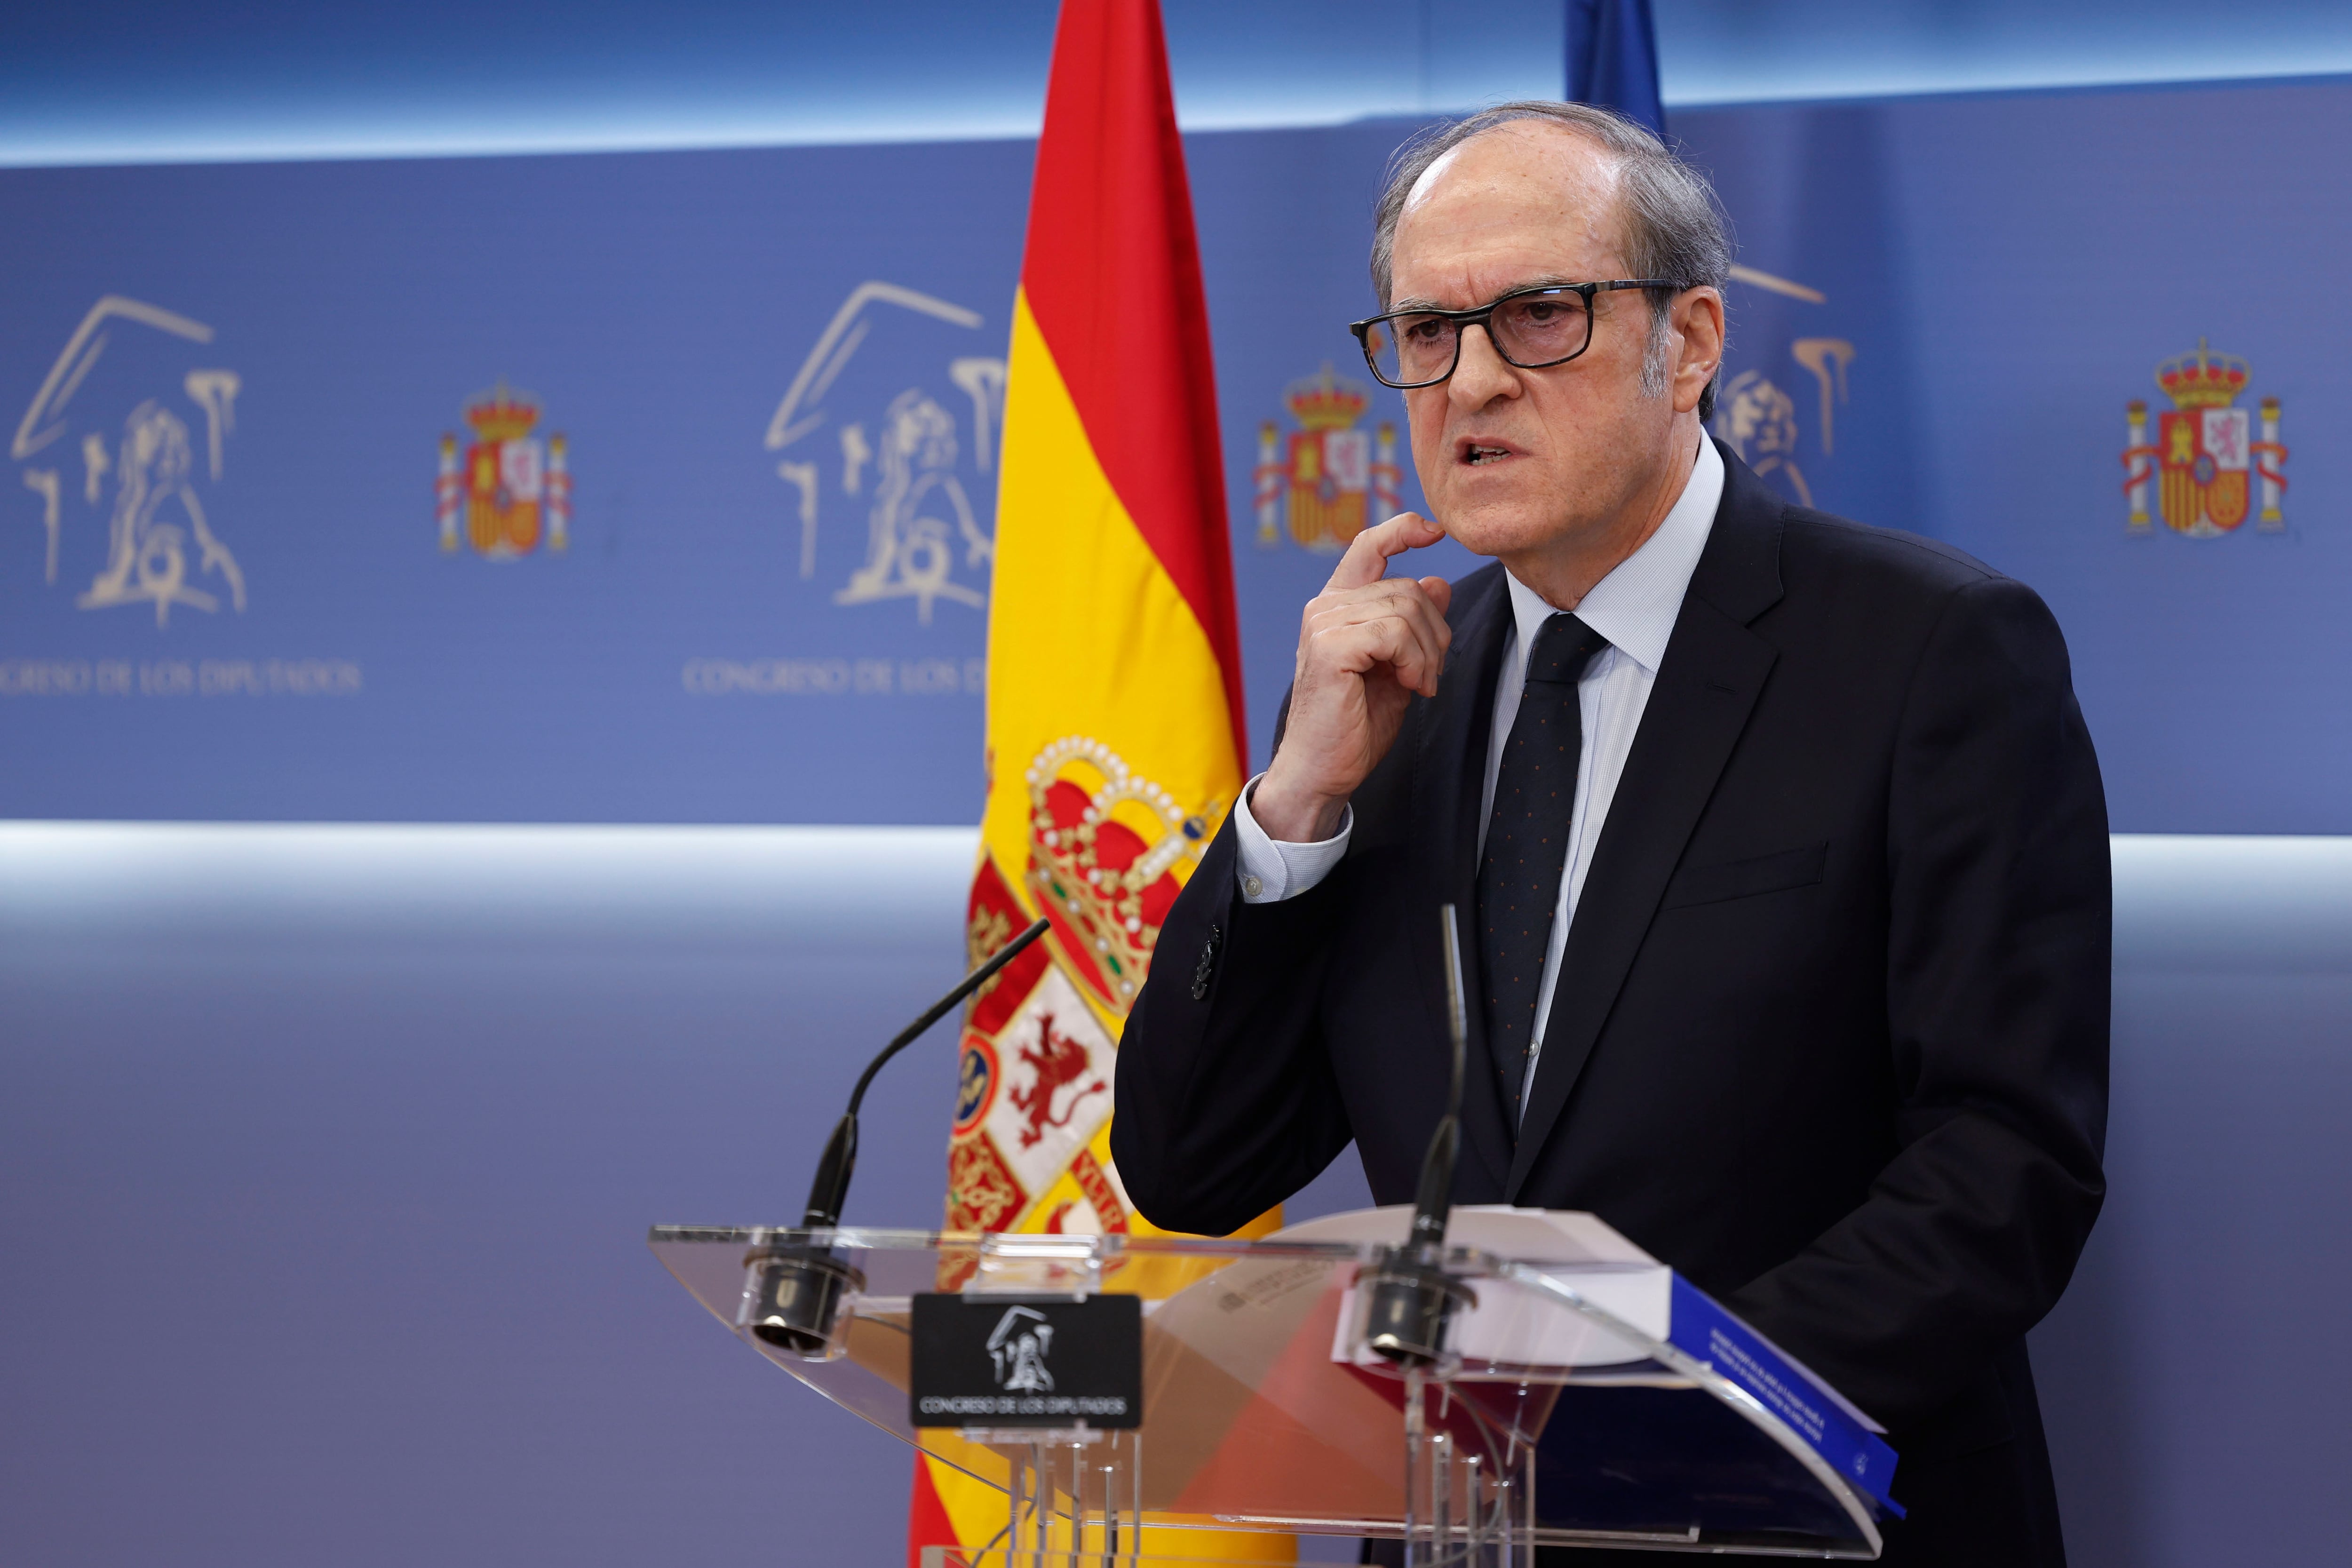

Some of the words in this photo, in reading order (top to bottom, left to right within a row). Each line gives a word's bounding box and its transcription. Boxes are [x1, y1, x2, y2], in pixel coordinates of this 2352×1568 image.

[682, 657, 850, 695] CONGRESO
[854, 657, 892, 695] DE
[899, 657, 959, 695] LOS
[919, 1396, 997, 1414] CONGRESO
[996, 1396, 1017, 1414] DE
[1018, 1396, 1045, 1414] LOS
[1045, 1396, 1127, 1415] DIPUTADOS
